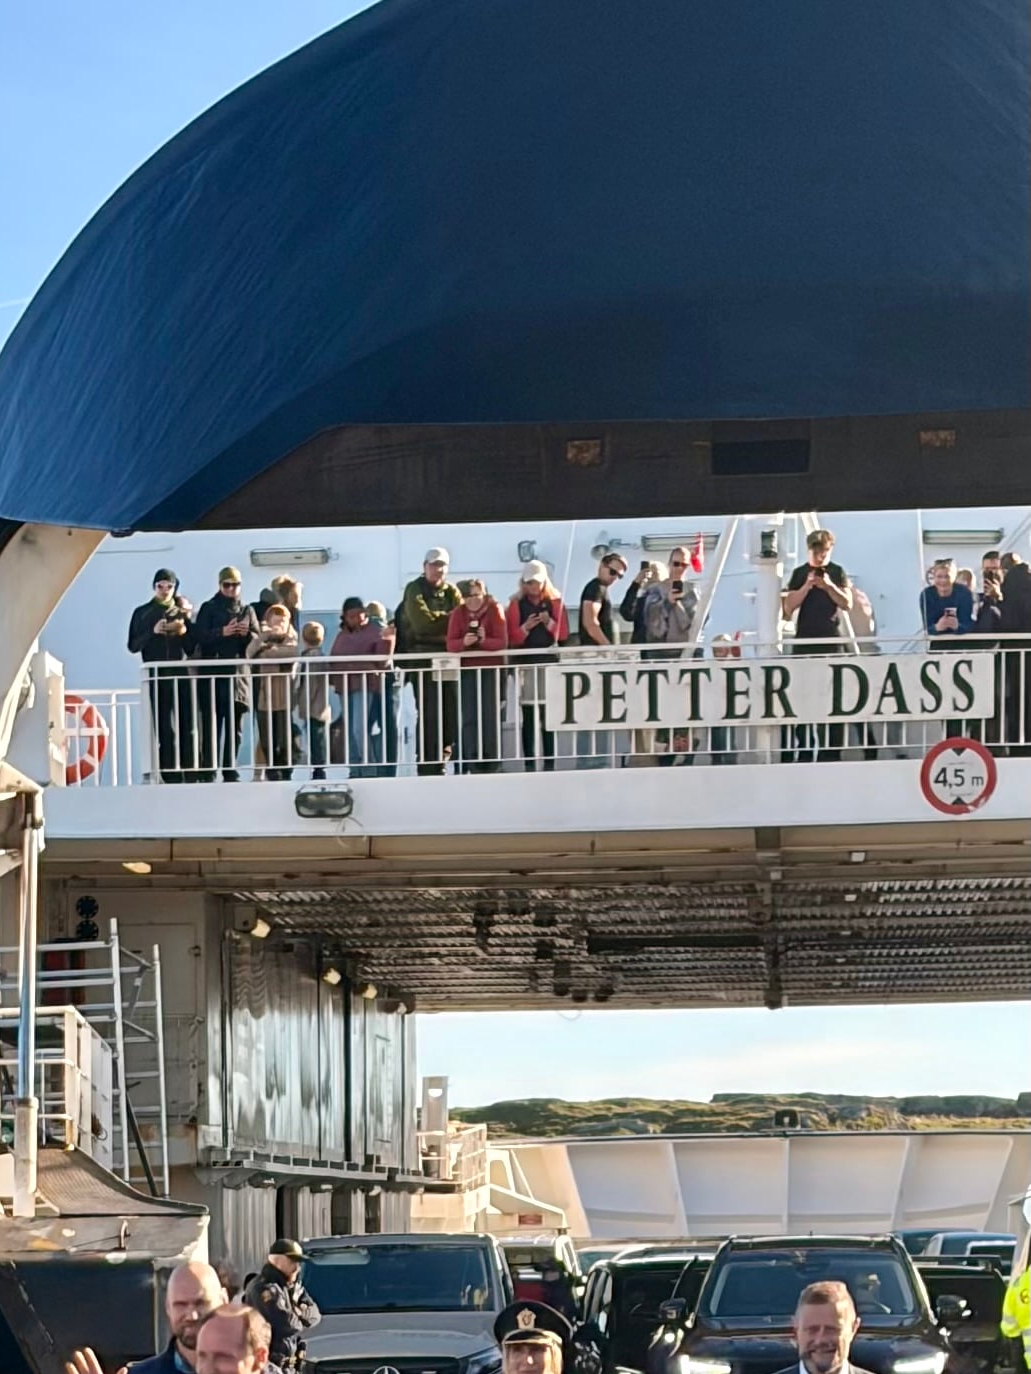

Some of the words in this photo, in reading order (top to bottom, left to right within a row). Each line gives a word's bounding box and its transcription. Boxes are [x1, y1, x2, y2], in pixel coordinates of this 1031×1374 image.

[561, 665, 797, 725] PETTER
[828, 659, 975, 717] DASS
[934, 766, 965, 788] 4,5
[971, 775, 984, 787] m
